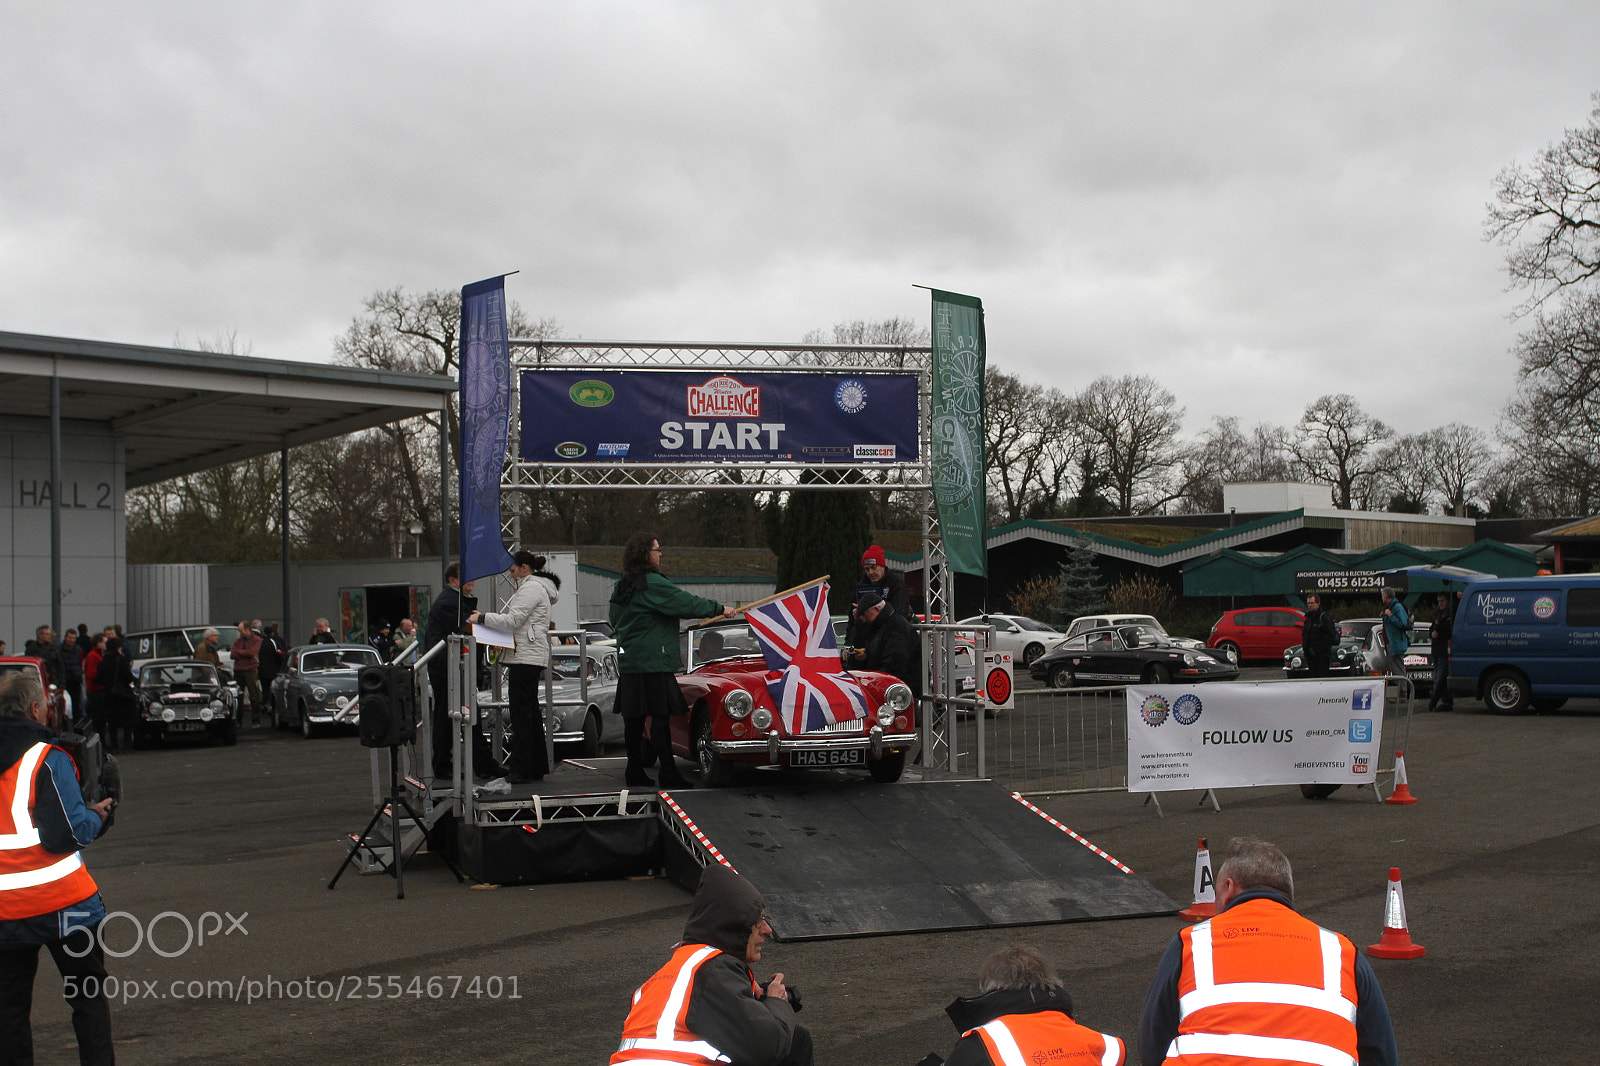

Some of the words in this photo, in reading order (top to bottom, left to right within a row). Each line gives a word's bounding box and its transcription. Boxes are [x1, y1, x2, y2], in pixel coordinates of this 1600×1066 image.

[837, 380, 852, 398] CLASSIC
[854, 381, 868, 397] RALLY
[690, 388, 758, 416] CHALLENGE
[837, 400, 867, 414] ASSOCIATION
[660, 421, 786, 450] START
[20, 479, 87, 509] HALL
[96, 482, 111, 509] 2
[1317, 578, 1348, 588] 01455
[1350, 576, 1385, 587] 612341
[1477, 593, 1515, 607] MAULDEN
[1482, 604, 1517, 618] GARAGE
[139, 637, 150, 654] 19
[1318, 696, 1349, 705] /herorally
[1202, 729, 1269, 745] FOLLOW
[1273, 729, 1294, 743] US
[1305, 728, 1346, 737] @HERO_CRA
[797, 751, 827, 765] HAS
[830, 750, 859, 763] 649
[1294, 761, 1345, 769] HEROEVENTSEU
[1353, 755, 1368, 765] You
[1353, 765, 1368, 773] Tube
[1199, 865, 1215, 893] A
[1048, 1047, 1064, 1056] LIVE
